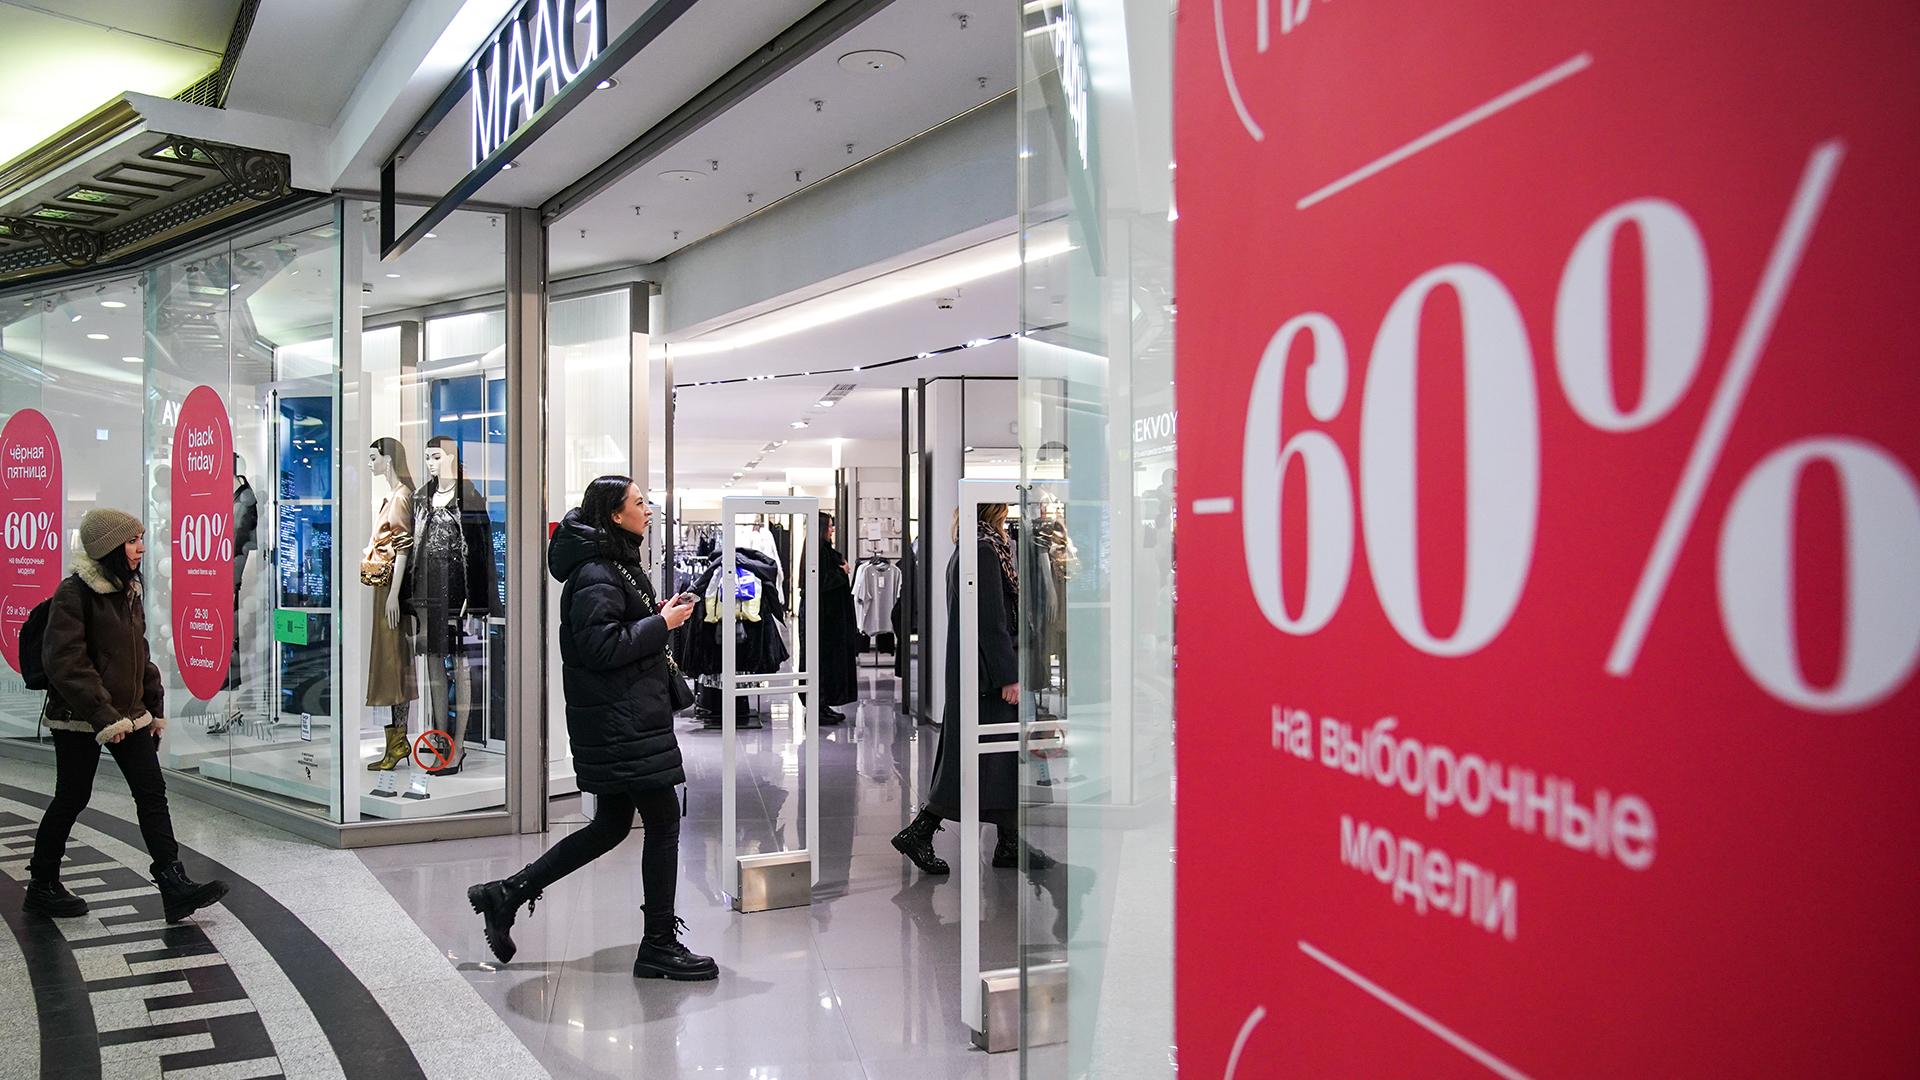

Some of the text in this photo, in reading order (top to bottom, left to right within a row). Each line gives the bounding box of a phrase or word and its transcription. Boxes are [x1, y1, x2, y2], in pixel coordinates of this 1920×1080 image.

[471, 0, 600, 170] MAAG
[188, 425, 214, 448] black
[1132, 410, 1178, 442] EKVOY
[1192, 138, 1920, 713] -60%
[9, 443, 44, 463] чёрная
[187, 450, 215, 475] friday
[7, 465, 47, 480] пятница
[0, 511, 58, 550] -60%
[172, 513, 232, 562] -60%
[189, 621, 214, 631] november
[194, 608, 209, 619] 29-30
[189, 656, 214, 668] december
[199, 645, 203, 655] 1
[1271, 704, 1658, 871] на выборочные
[1339, 815, 1518, 942] модели
